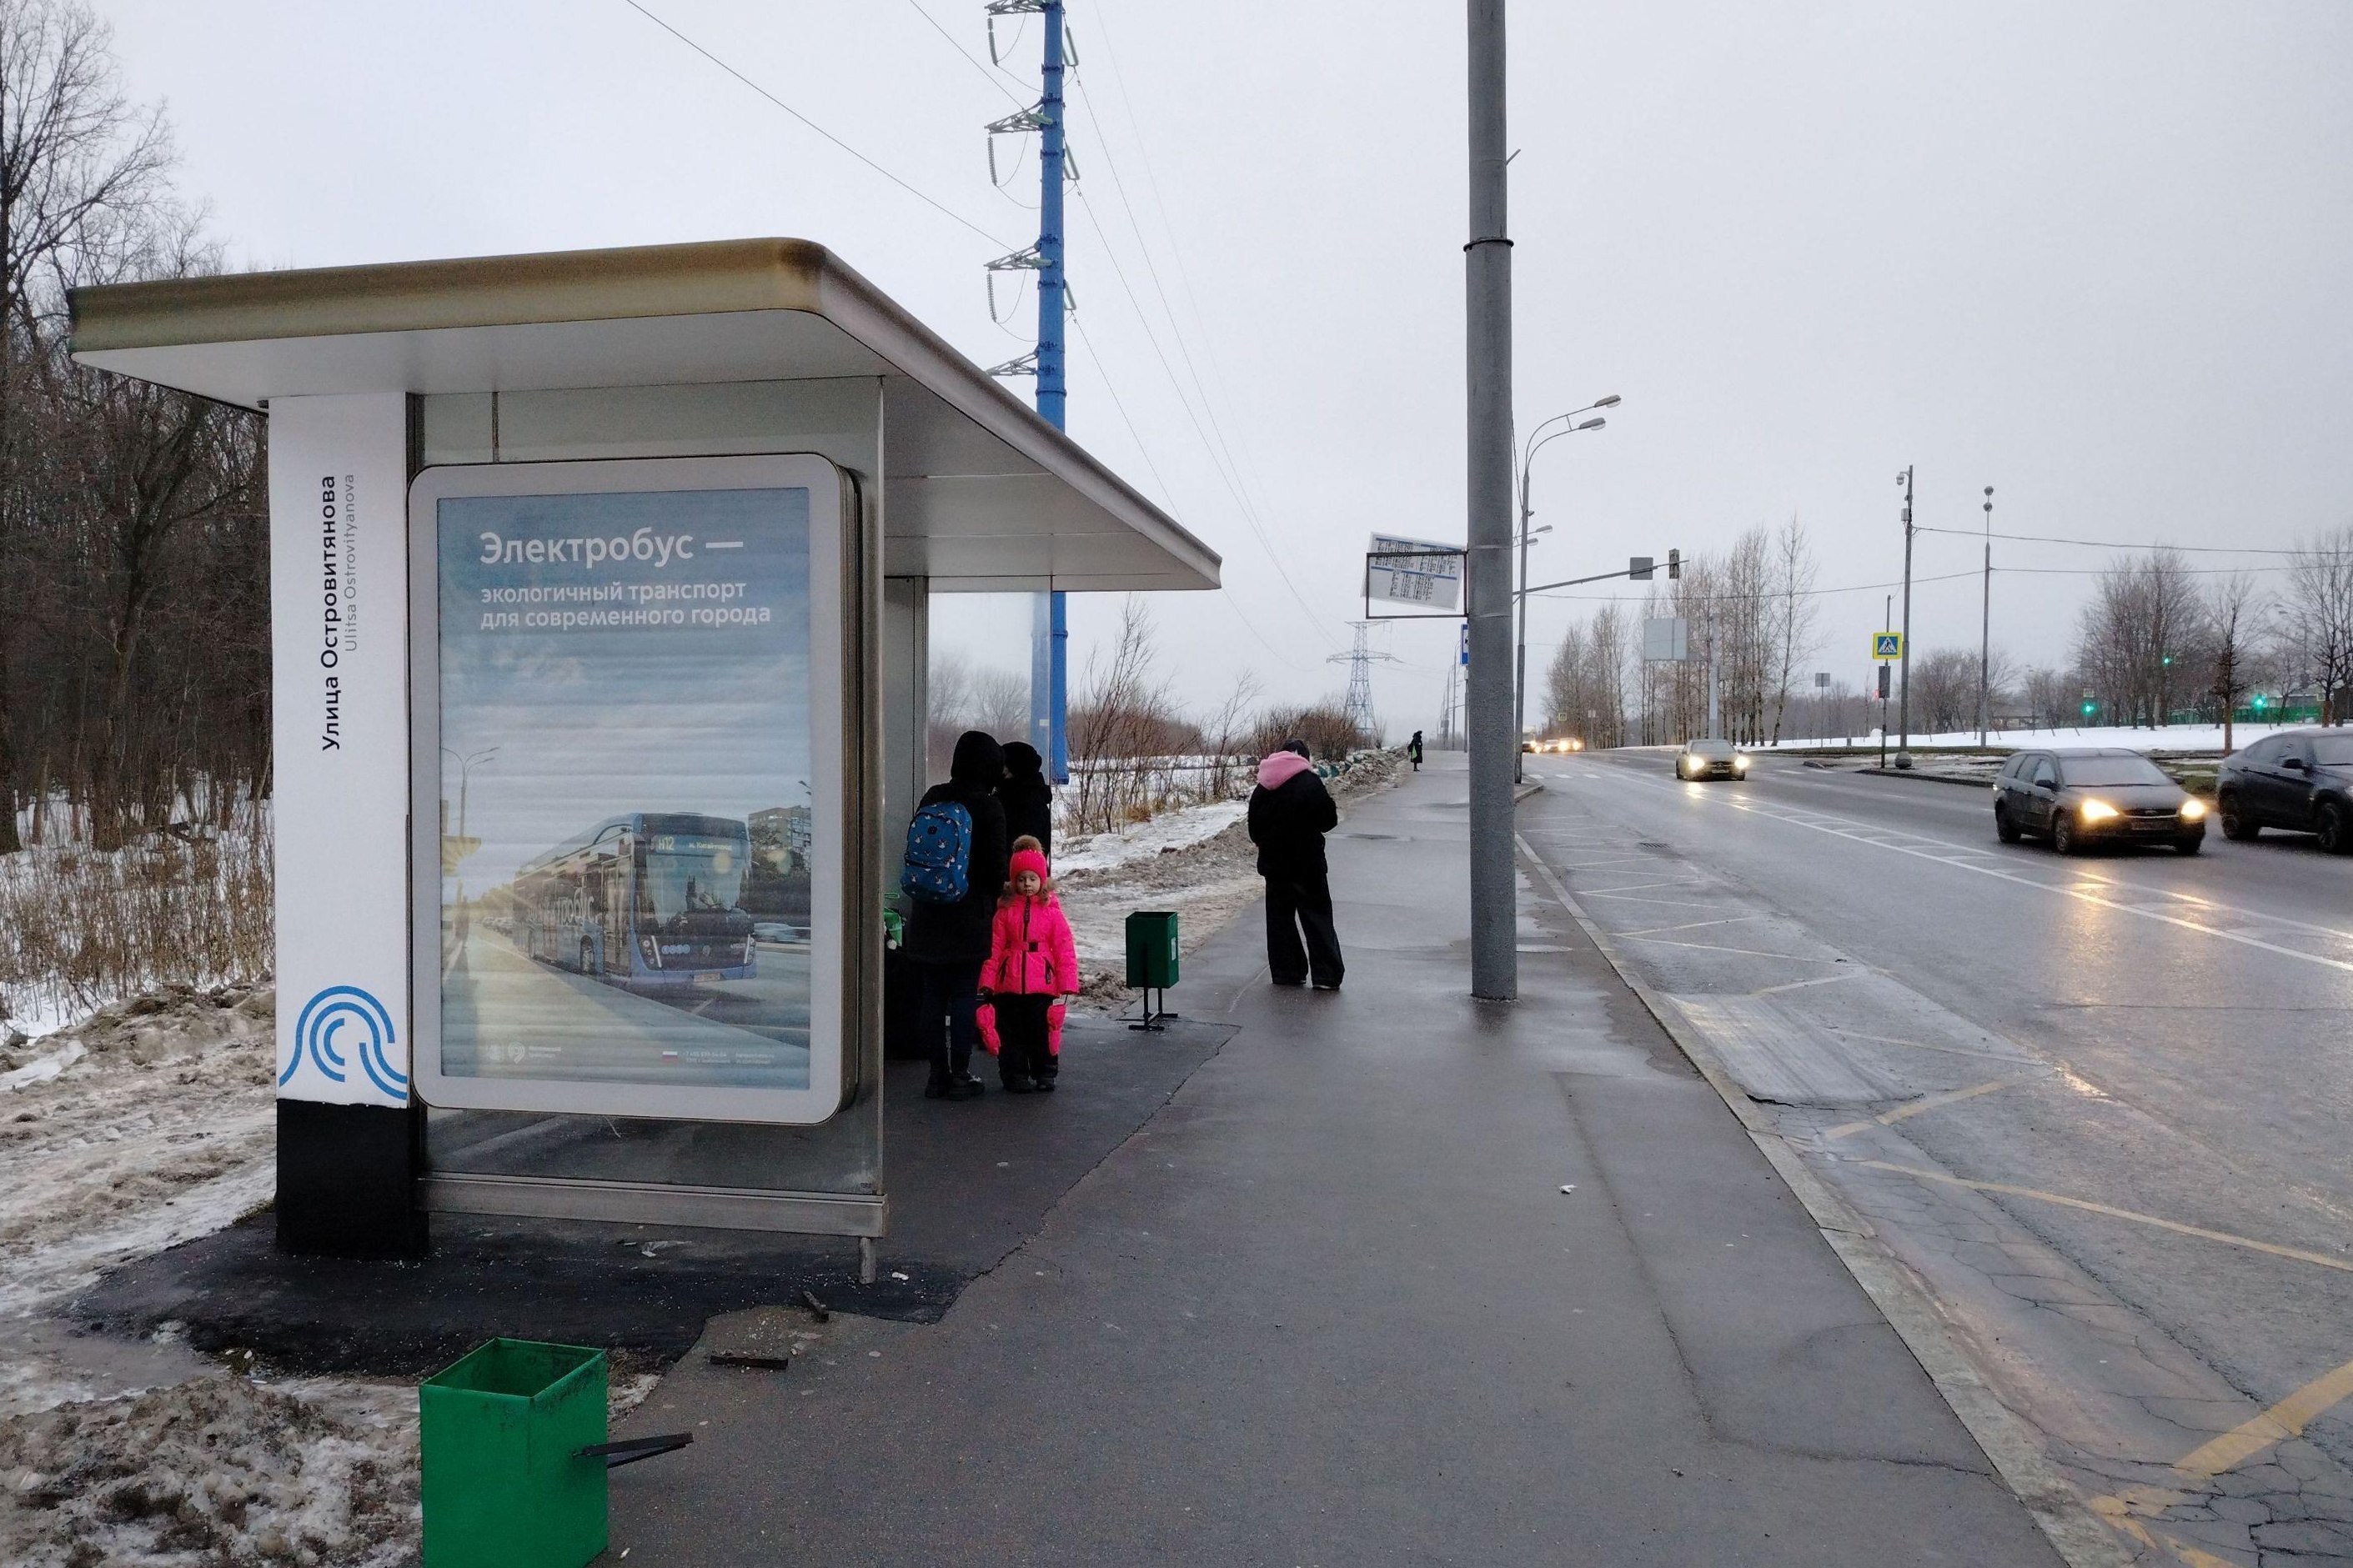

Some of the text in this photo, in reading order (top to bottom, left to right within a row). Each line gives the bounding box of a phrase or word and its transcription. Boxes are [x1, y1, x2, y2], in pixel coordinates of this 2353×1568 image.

[344, 473, 359, 652] Ulitsa Ostrovityanova
[479, 527, 694, 569] Электробус
[320, 475, 342, 751] Улица Островитянова
[480, 582, 747, 604] экологичный транспорт
[480, 606, 771, 630] для современного города
